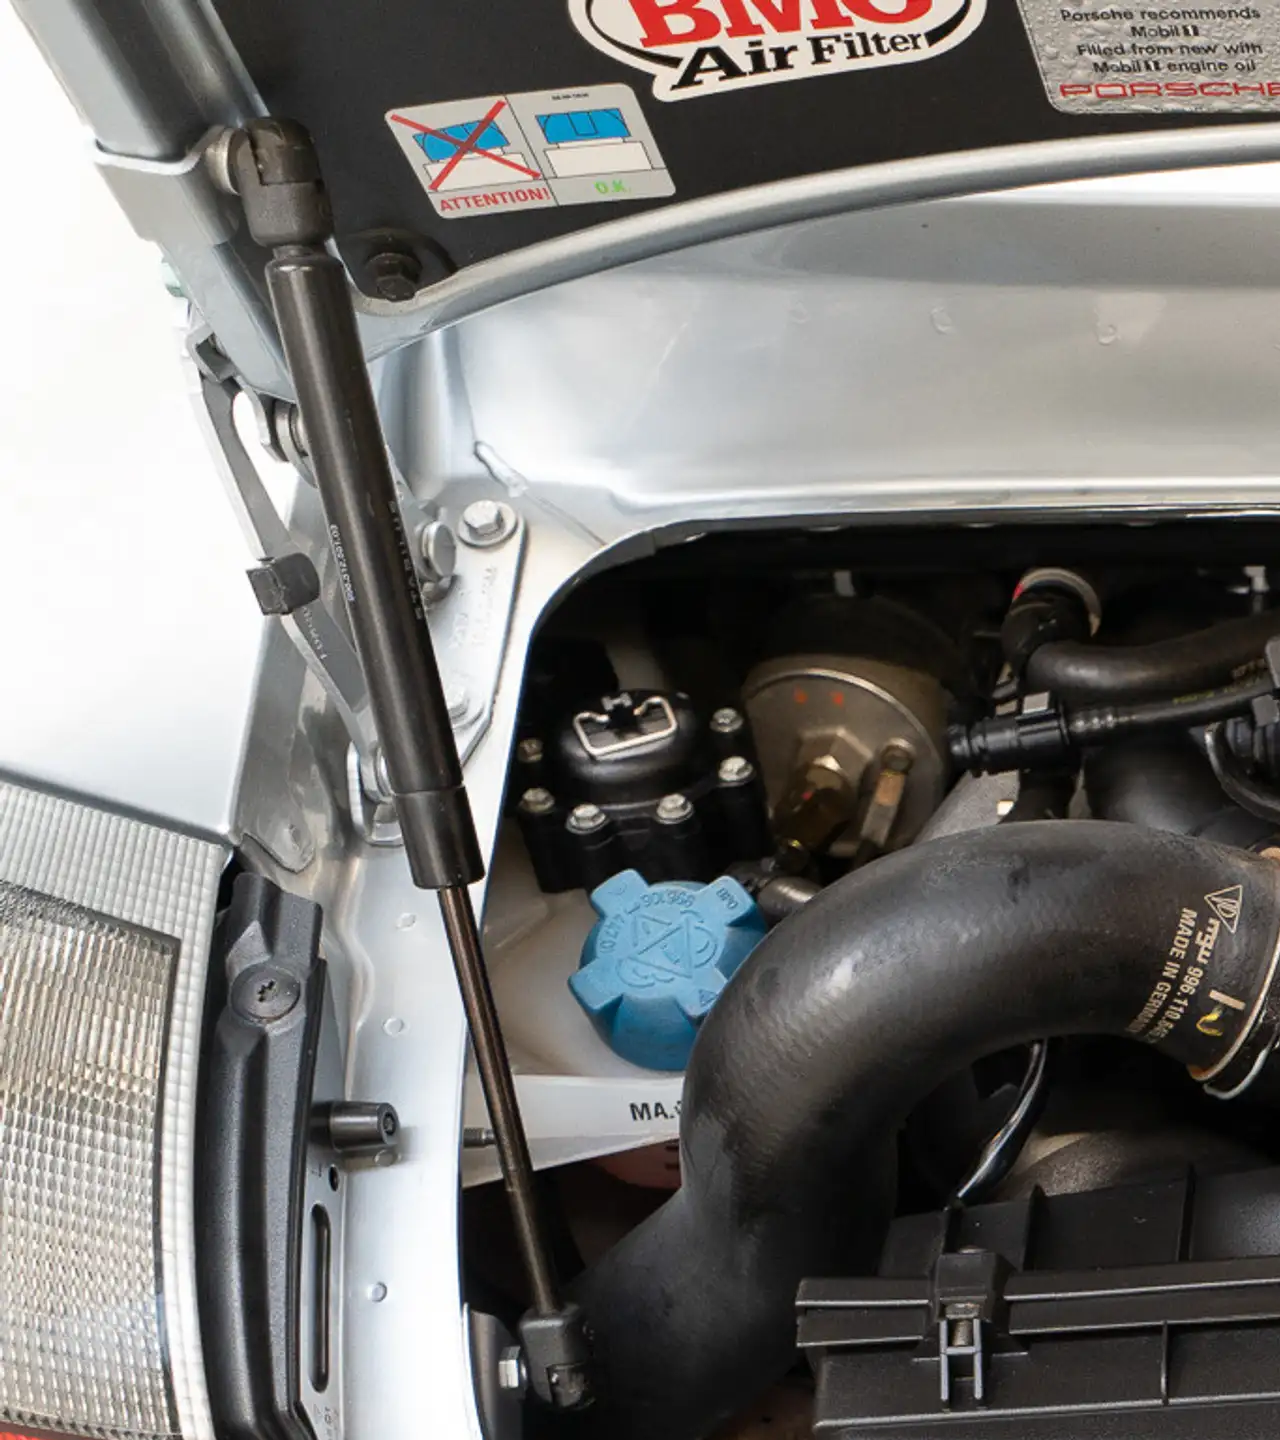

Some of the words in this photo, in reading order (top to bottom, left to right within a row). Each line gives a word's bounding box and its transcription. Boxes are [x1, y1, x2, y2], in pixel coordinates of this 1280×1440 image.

[1060, 9, 1133, 22] Porsche
[1140, 7, 1261, 20] recommends
[1131, 25, 1179, 38] Mobil
[1077, 44, 1125, 56] Filled
[1131, 43, 1173, 56] from
[1180, 45, 1216, 56] new
[1224, 42, 1263, 54] with
[670, 40, 798, 91] Air
[806, 31, 925, 65] Filter
[1093, 60, 1141, 73] Mobil
[1167, 60, 1229, 75] engine
[1234, 58, 1255, 72] oil
[440, 187, 550, 212] ATTENTION!
[1169, 908, 1197, 959] MADE
[1162, 961, 1180, 979] IN
[1125, 981, 1172, 1034] GERM
